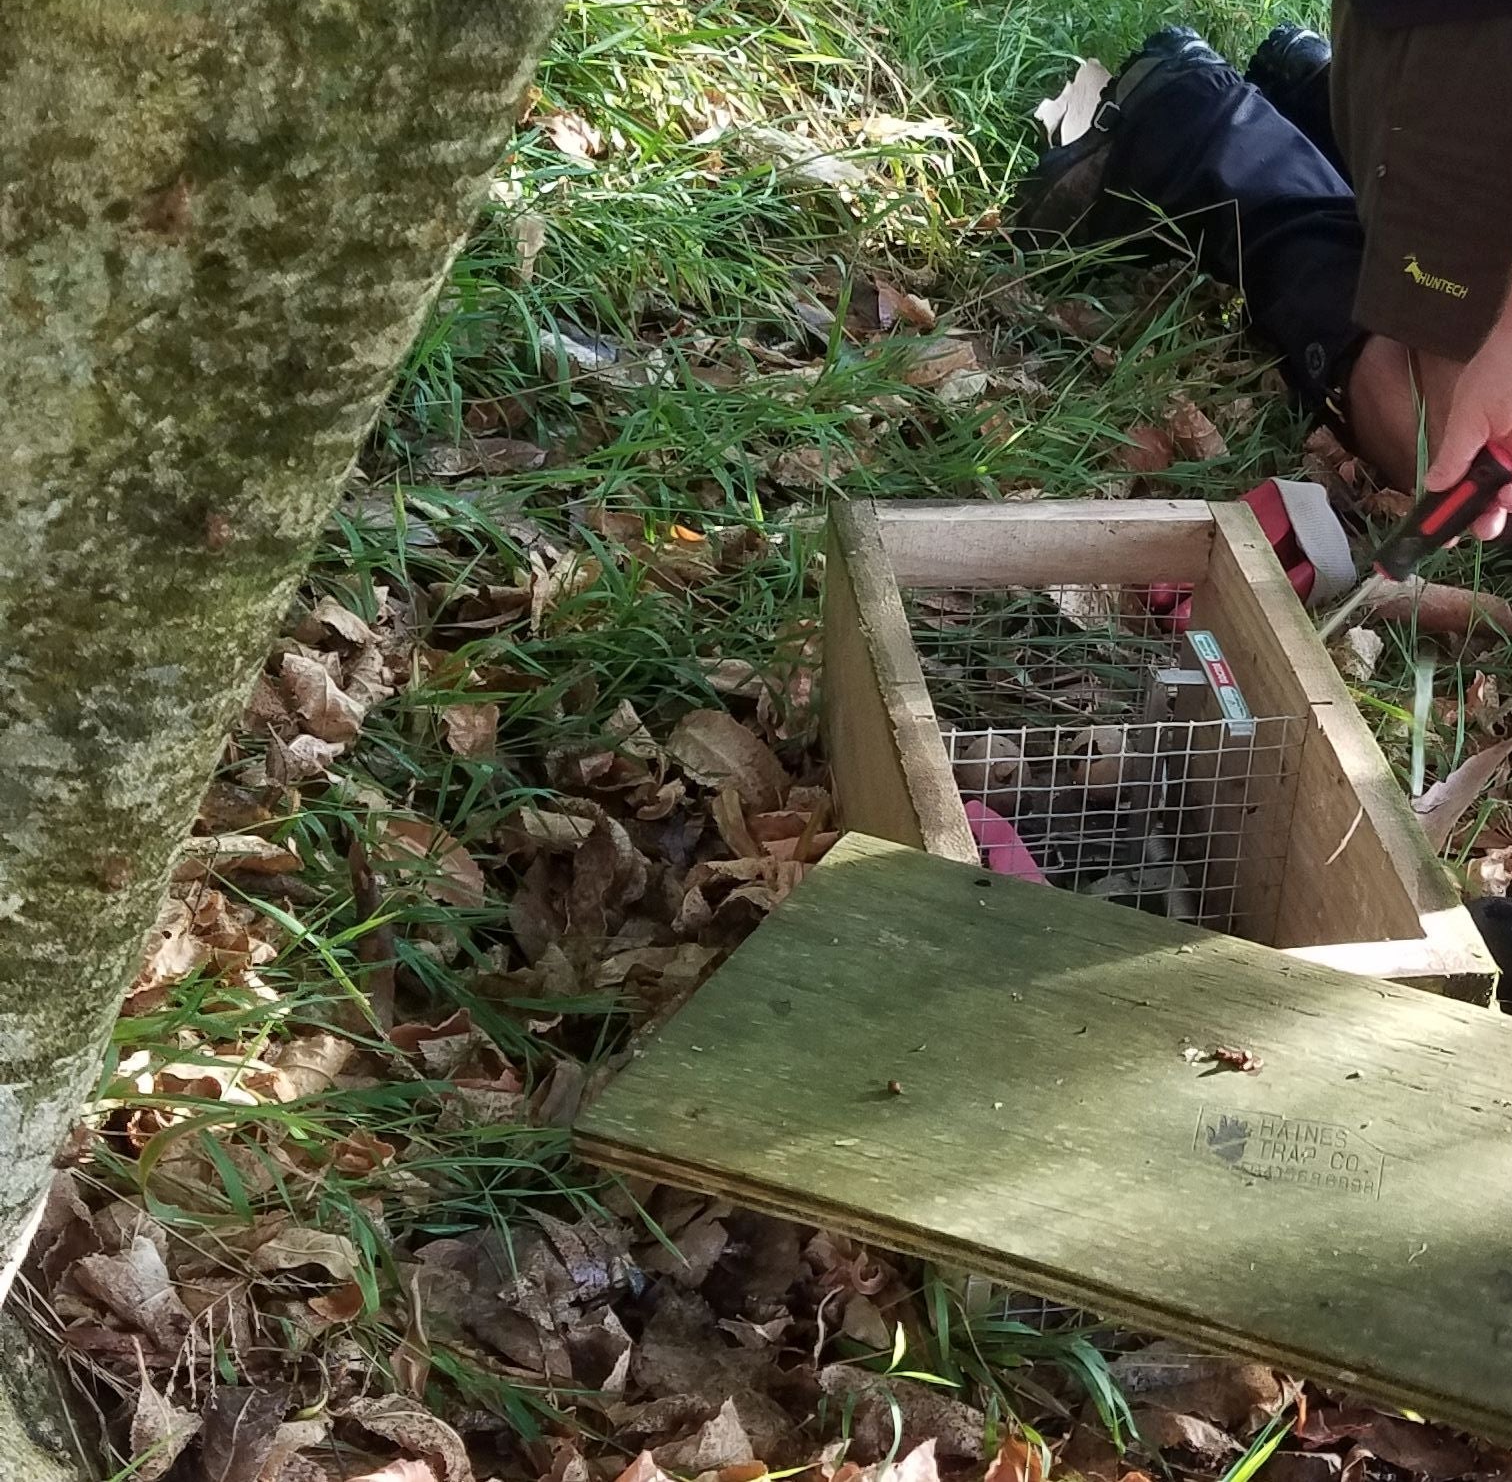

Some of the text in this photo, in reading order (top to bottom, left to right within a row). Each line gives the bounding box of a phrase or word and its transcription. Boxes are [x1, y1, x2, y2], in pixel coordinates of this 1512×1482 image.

[1418, 272, 1468, 298] HUNTECH
[1260, 1119, 1348, 1149] HAINES
[1260, 1138, 1370, 1174] TRAP CO.
